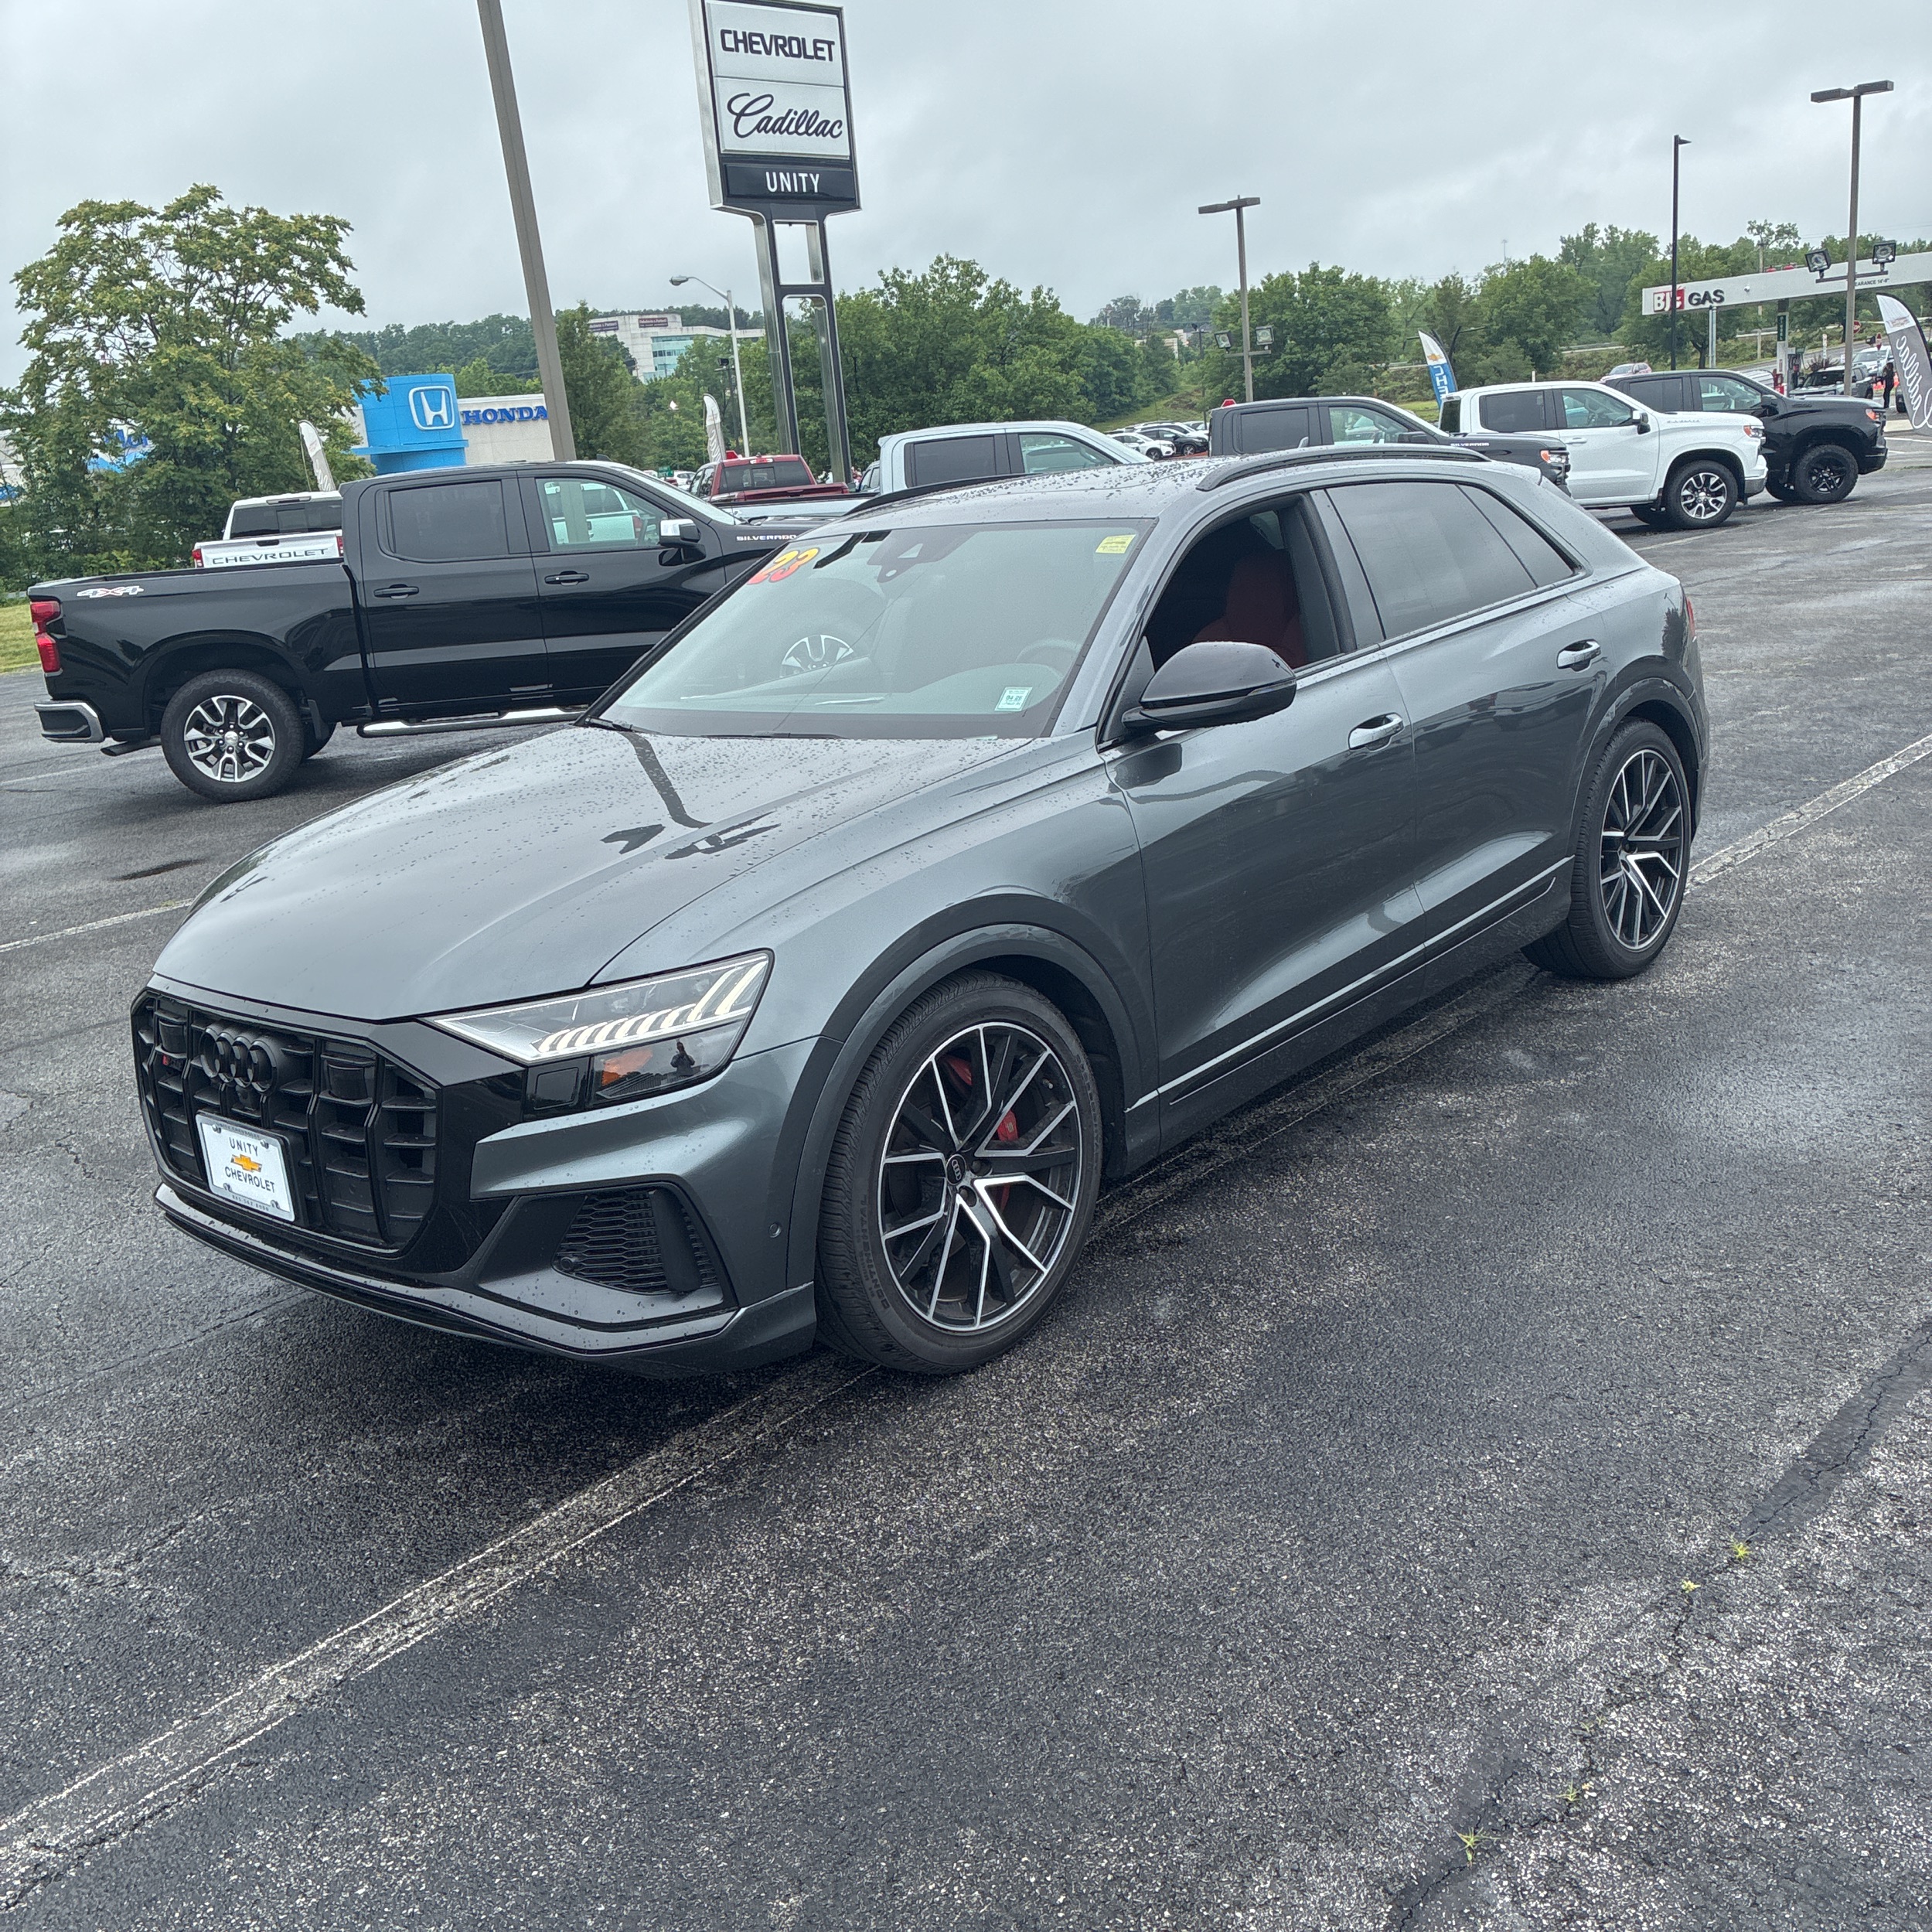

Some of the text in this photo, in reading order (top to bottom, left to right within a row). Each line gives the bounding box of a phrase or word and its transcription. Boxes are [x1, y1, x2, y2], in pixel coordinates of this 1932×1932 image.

[720, 29, 835, 62] CHEVROLET
[727, 92, 843, 139] Cadillac
[765, 171, 819, 193] UNITY
[1688, 289, 1725, 306] GAS
[461, 406, 548, 425] HONDA
[213, 548, 328, 564] CHEVROLET
[229, 1136, 258, 1157] UNITY
[224, 1166, 275, 1193] CHEVROLET
